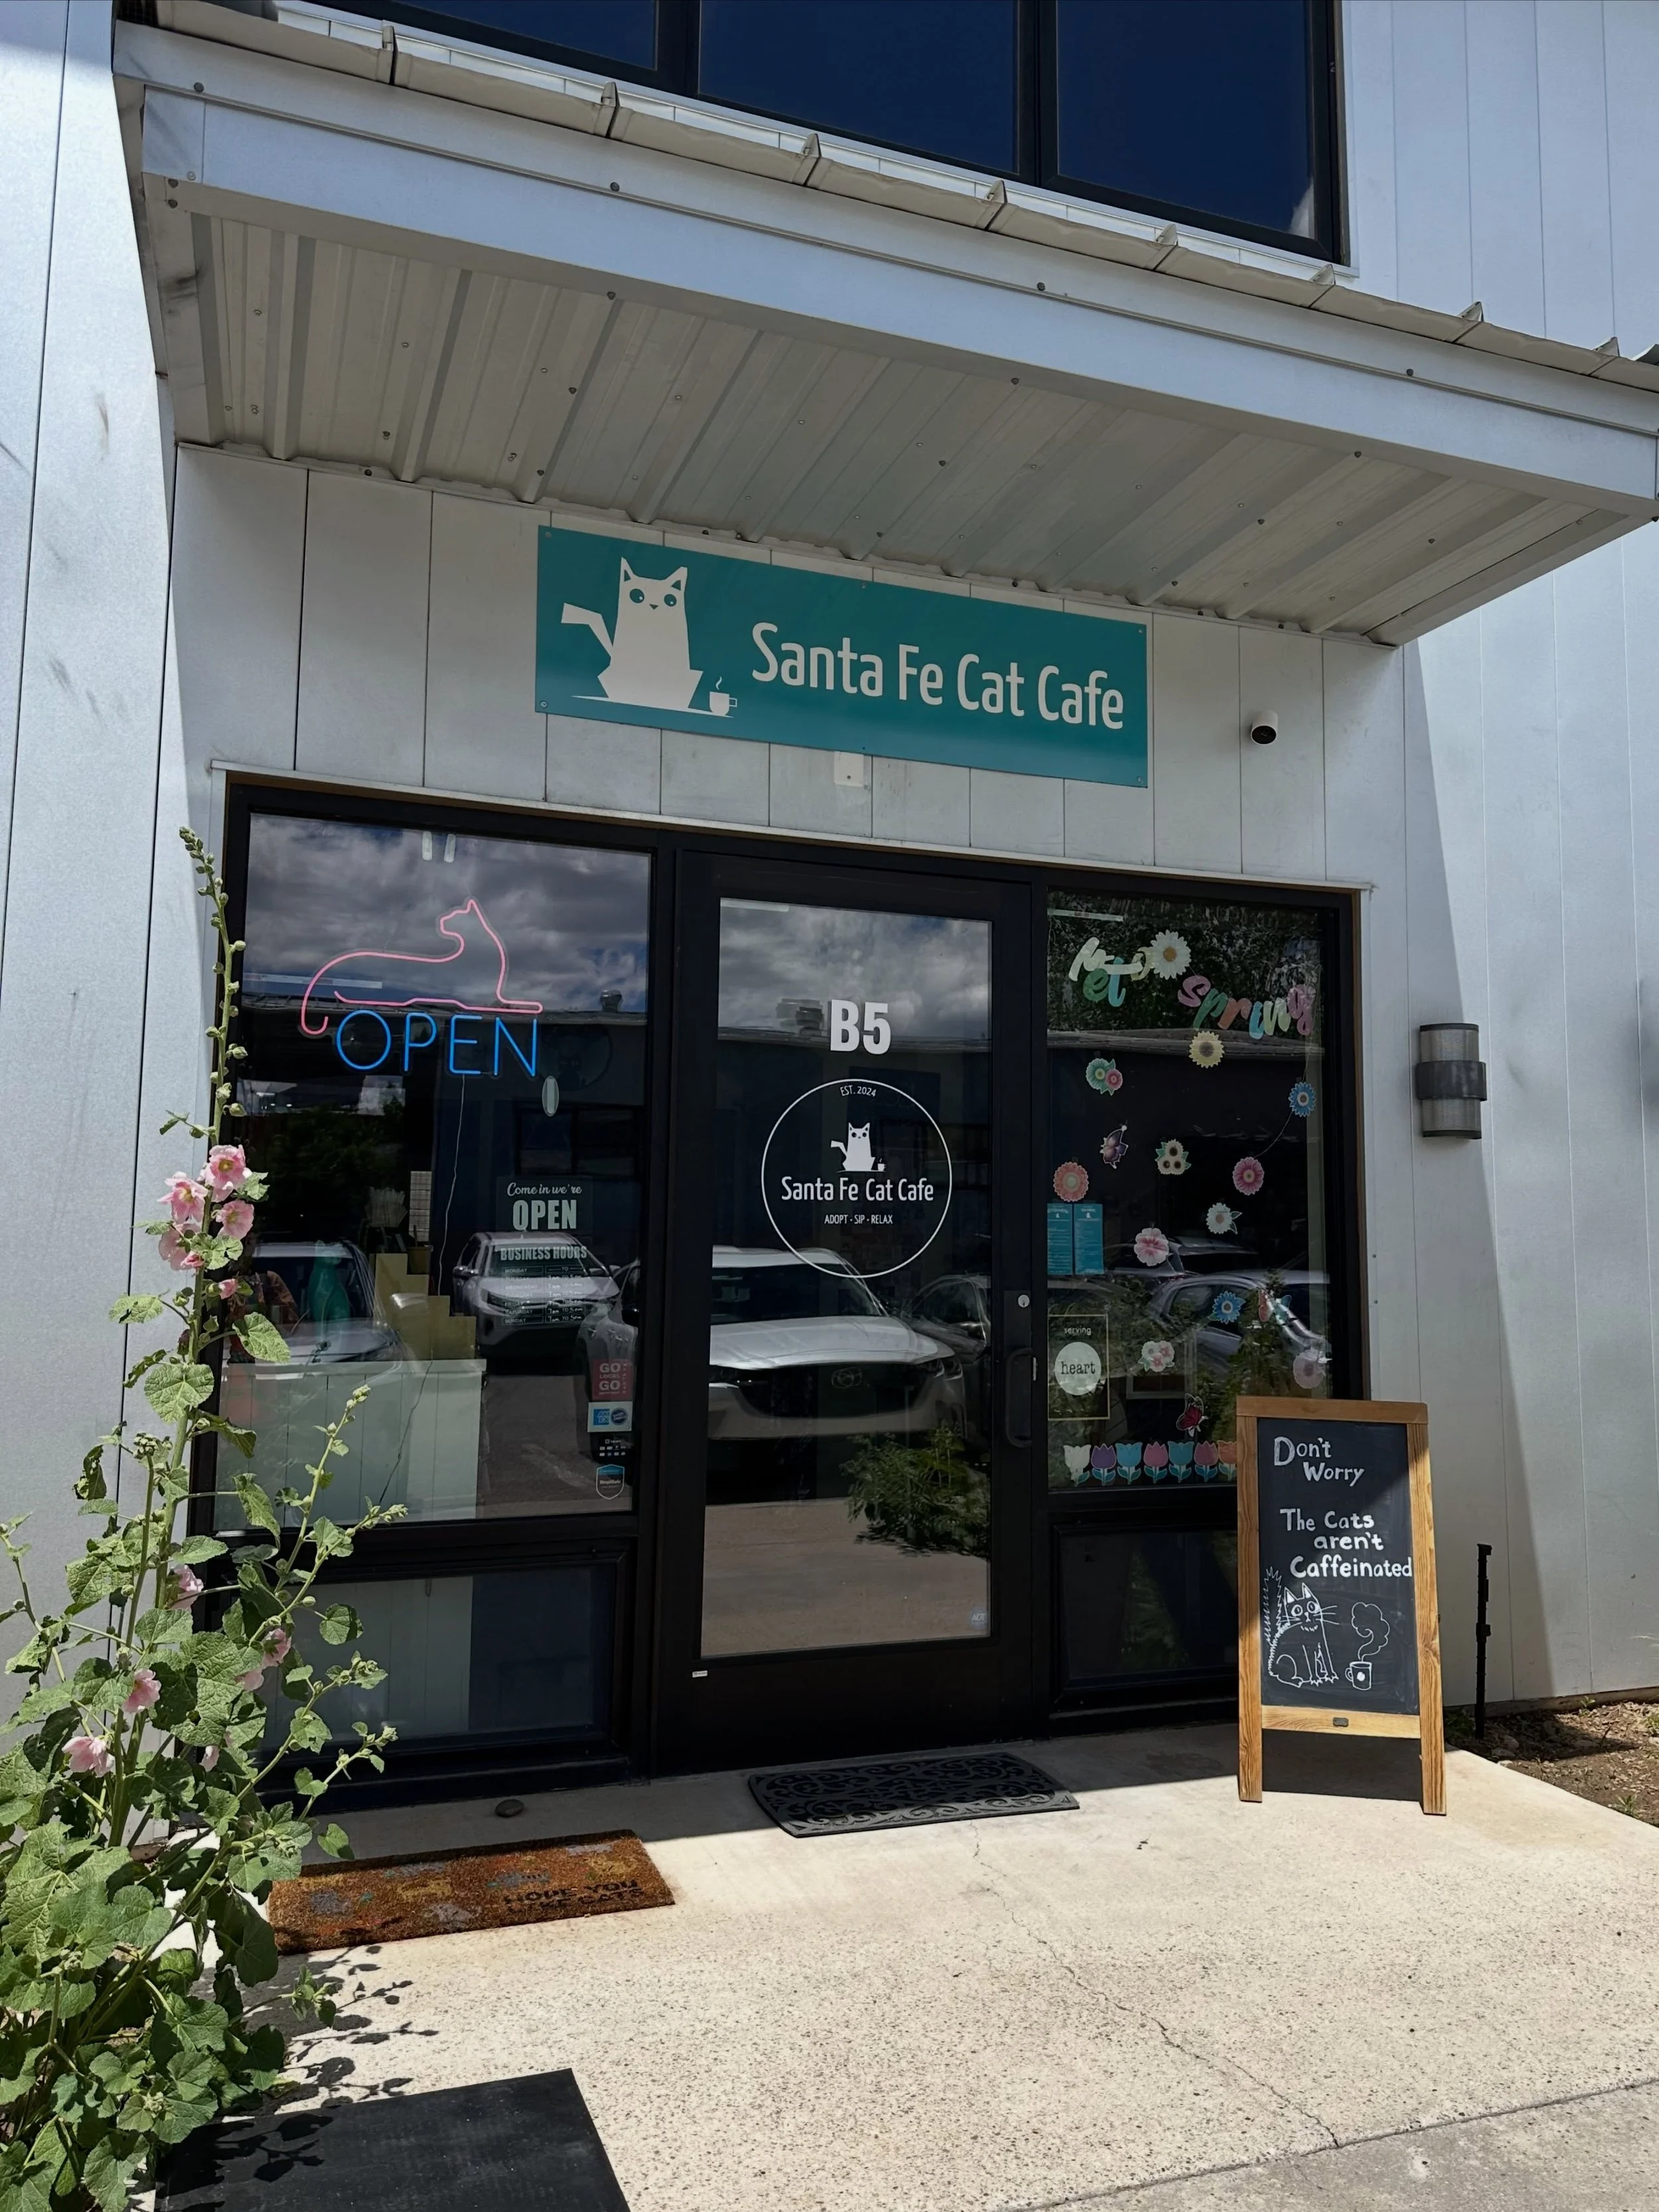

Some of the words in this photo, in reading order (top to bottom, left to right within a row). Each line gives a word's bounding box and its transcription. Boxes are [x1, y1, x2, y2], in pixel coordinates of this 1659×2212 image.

[752, 622, 883, 697] Santa
[899, 643, 944, 705] Fe
[957, 653, 1025, 717] Cat
[1037, 665, 1124, 729] Cafe
[830, 999, 891, 1055] B5
[335, 1009, 539, 1077] OPEN
[839, 1085, 856, 1096] EST.
[857, 1086, 877, 1097] 2024
[507, 1182, 538, 1197] Come
[538, 1183, 551, 1195] in
[551, 1183, 583, 1195] we're
[781, 1176, 834, 1201] Santa
[839, 1177, 859, 1201] Fe
[865, 1178, 893, 1201] Cat
[898, 1177, 934, 1201] Cafe
[512, 1199, 577, 1232] OPEN
[824, 1215, 849, 1224] ADOPT
[854, 1215, 865, 1224] SIP
[871, 1215, 893, 1224] RELAX
[500, 1246, 551, 1261] BUSINESS
[552, 1246, 587, 1259] HOURS
[1064, 1325, 1092, 1336] serving
[599, 1363, 621, 1374] GO
[1060, 1361, 1096, 1375] heart
[599, 1380, 621, 1391] GO
[1273, 1436, 1331, 1467] Don't
[1303, 1461, 1365, 1486] Worry
[1279, 1508, 1316, 1531] The
[1324, 1510, 1374, 1530] Cats
[1314, 1532, 1384, 1551] aren't
[1289, 1554, 1413, 1578] Caffeinated
